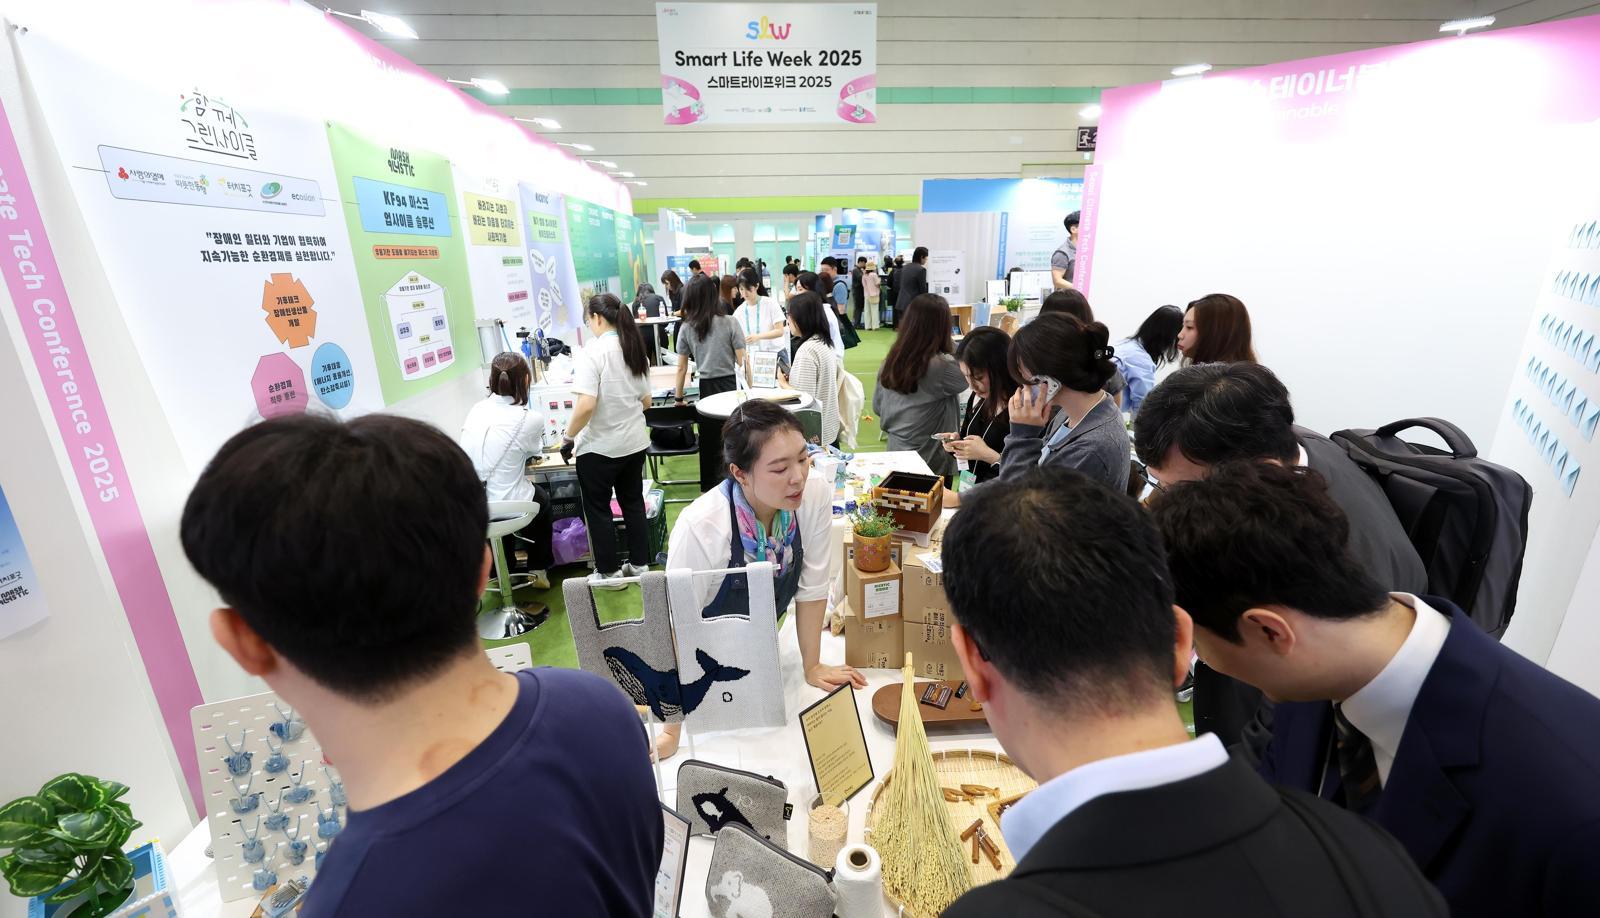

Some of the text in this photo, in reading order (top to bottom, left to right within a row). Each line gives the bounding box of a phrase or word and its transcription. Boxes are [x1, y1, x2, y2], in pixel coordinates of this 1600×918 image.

[675, 50, 862, 67] Smart Life Week 2025
[707, 76, 832, 88] 스마트라이프위크 2025
[383, 190, 430, 210] KF94 마스크
[384, 212, 434, 230] 업사이클 솔루션
[245, 234, 270, 246] 일터와
[273, 234, 296, 246] 기업이
[298, 236, 327, 246] 협력하여
[200, 250, 250, 262] 지속가능한
[252, 250, 292, 262] 순환경제를
[276, 295, 300, 304] 기후테크
[8, 229, 46, 290] Tech
[33, 298, 92, 435] Conference
[83, 443, 120, 503] 2025
[268, 380, 292, 393] 순환경제
